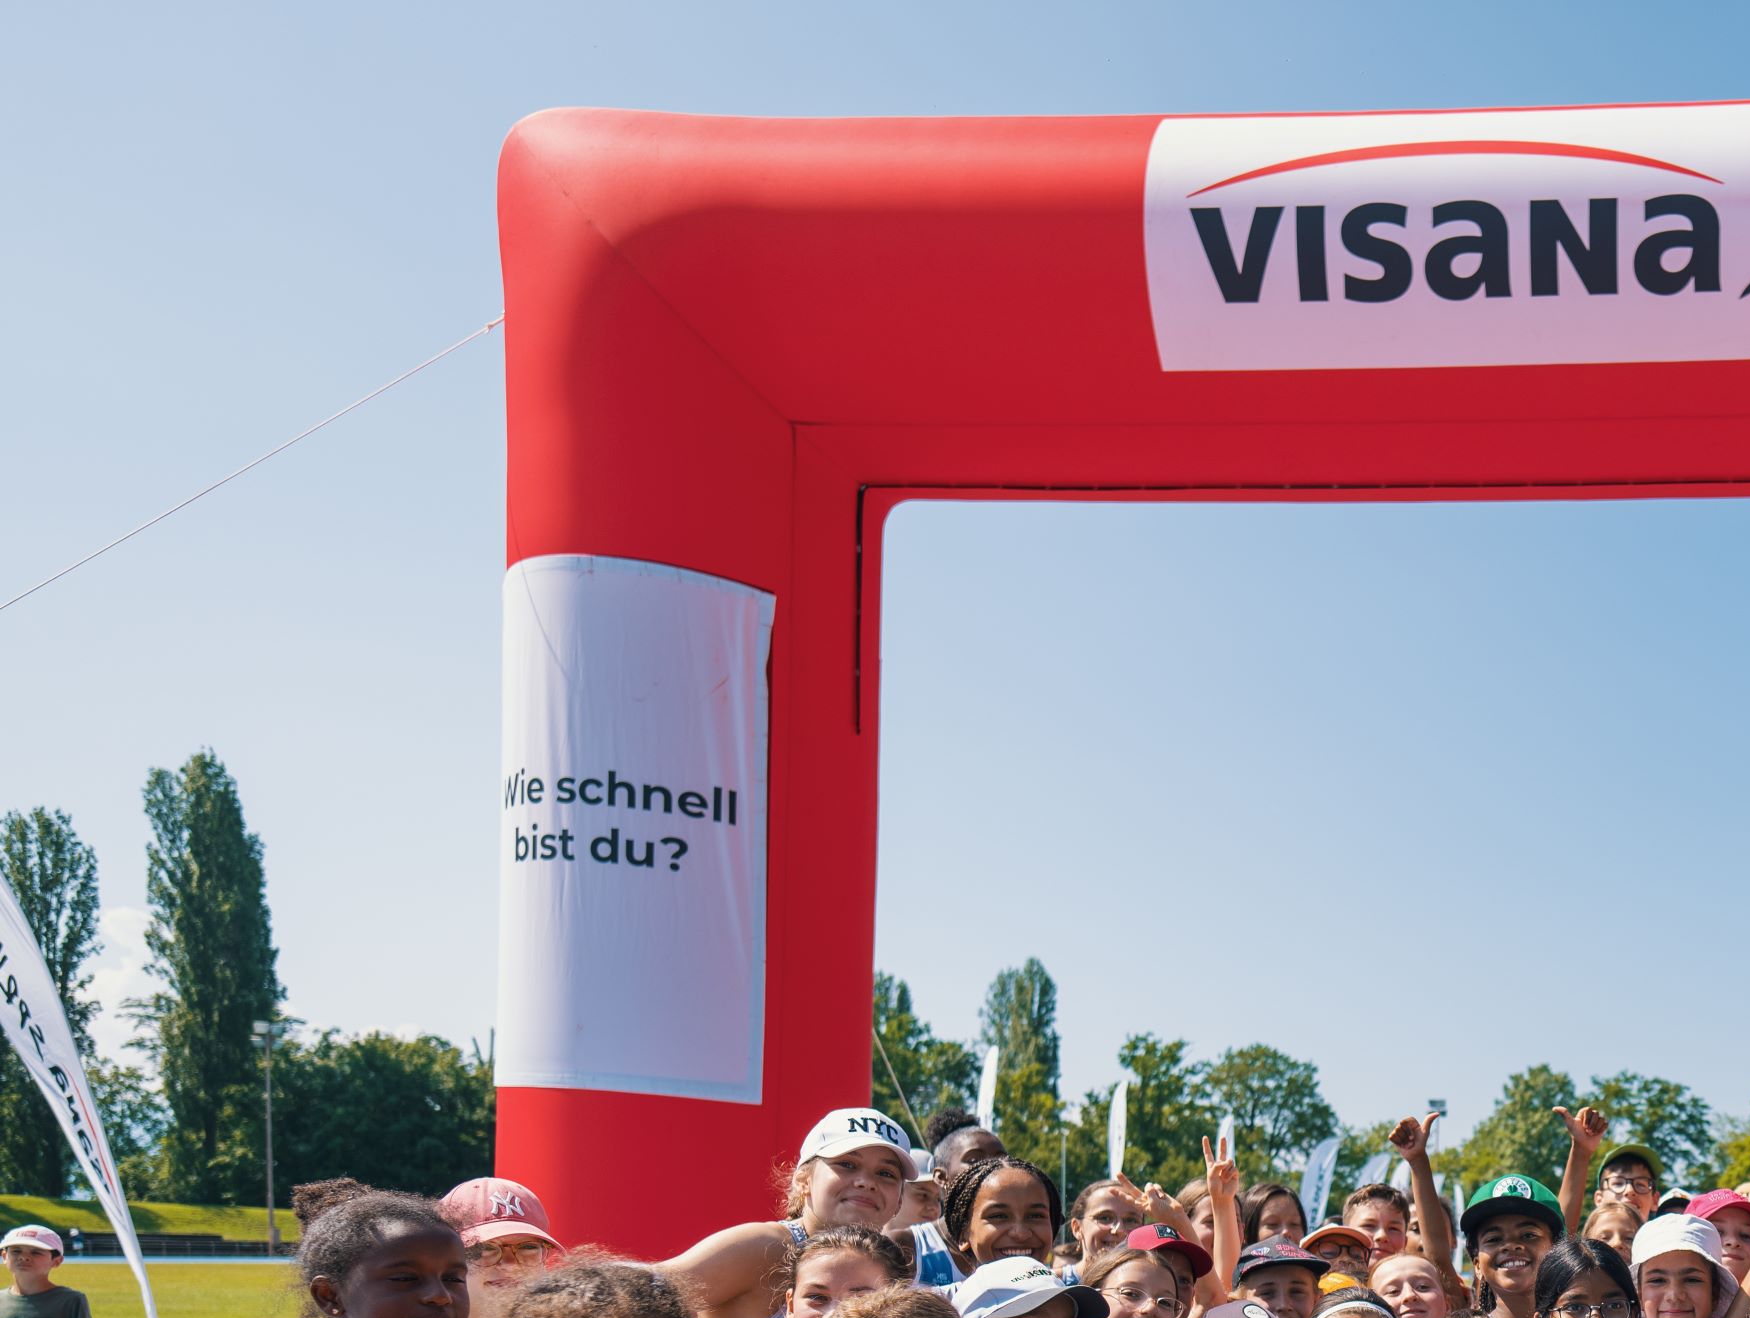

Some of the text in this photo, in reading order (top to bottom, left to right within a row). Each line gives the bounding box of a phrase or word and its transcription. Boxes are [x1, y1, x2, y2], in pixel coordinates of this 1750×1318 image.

[504, 768, 737, 826] Wie schnell
[515, 823, 688, 872] bist du?
[847, 1117, 899, 1145] NYC
